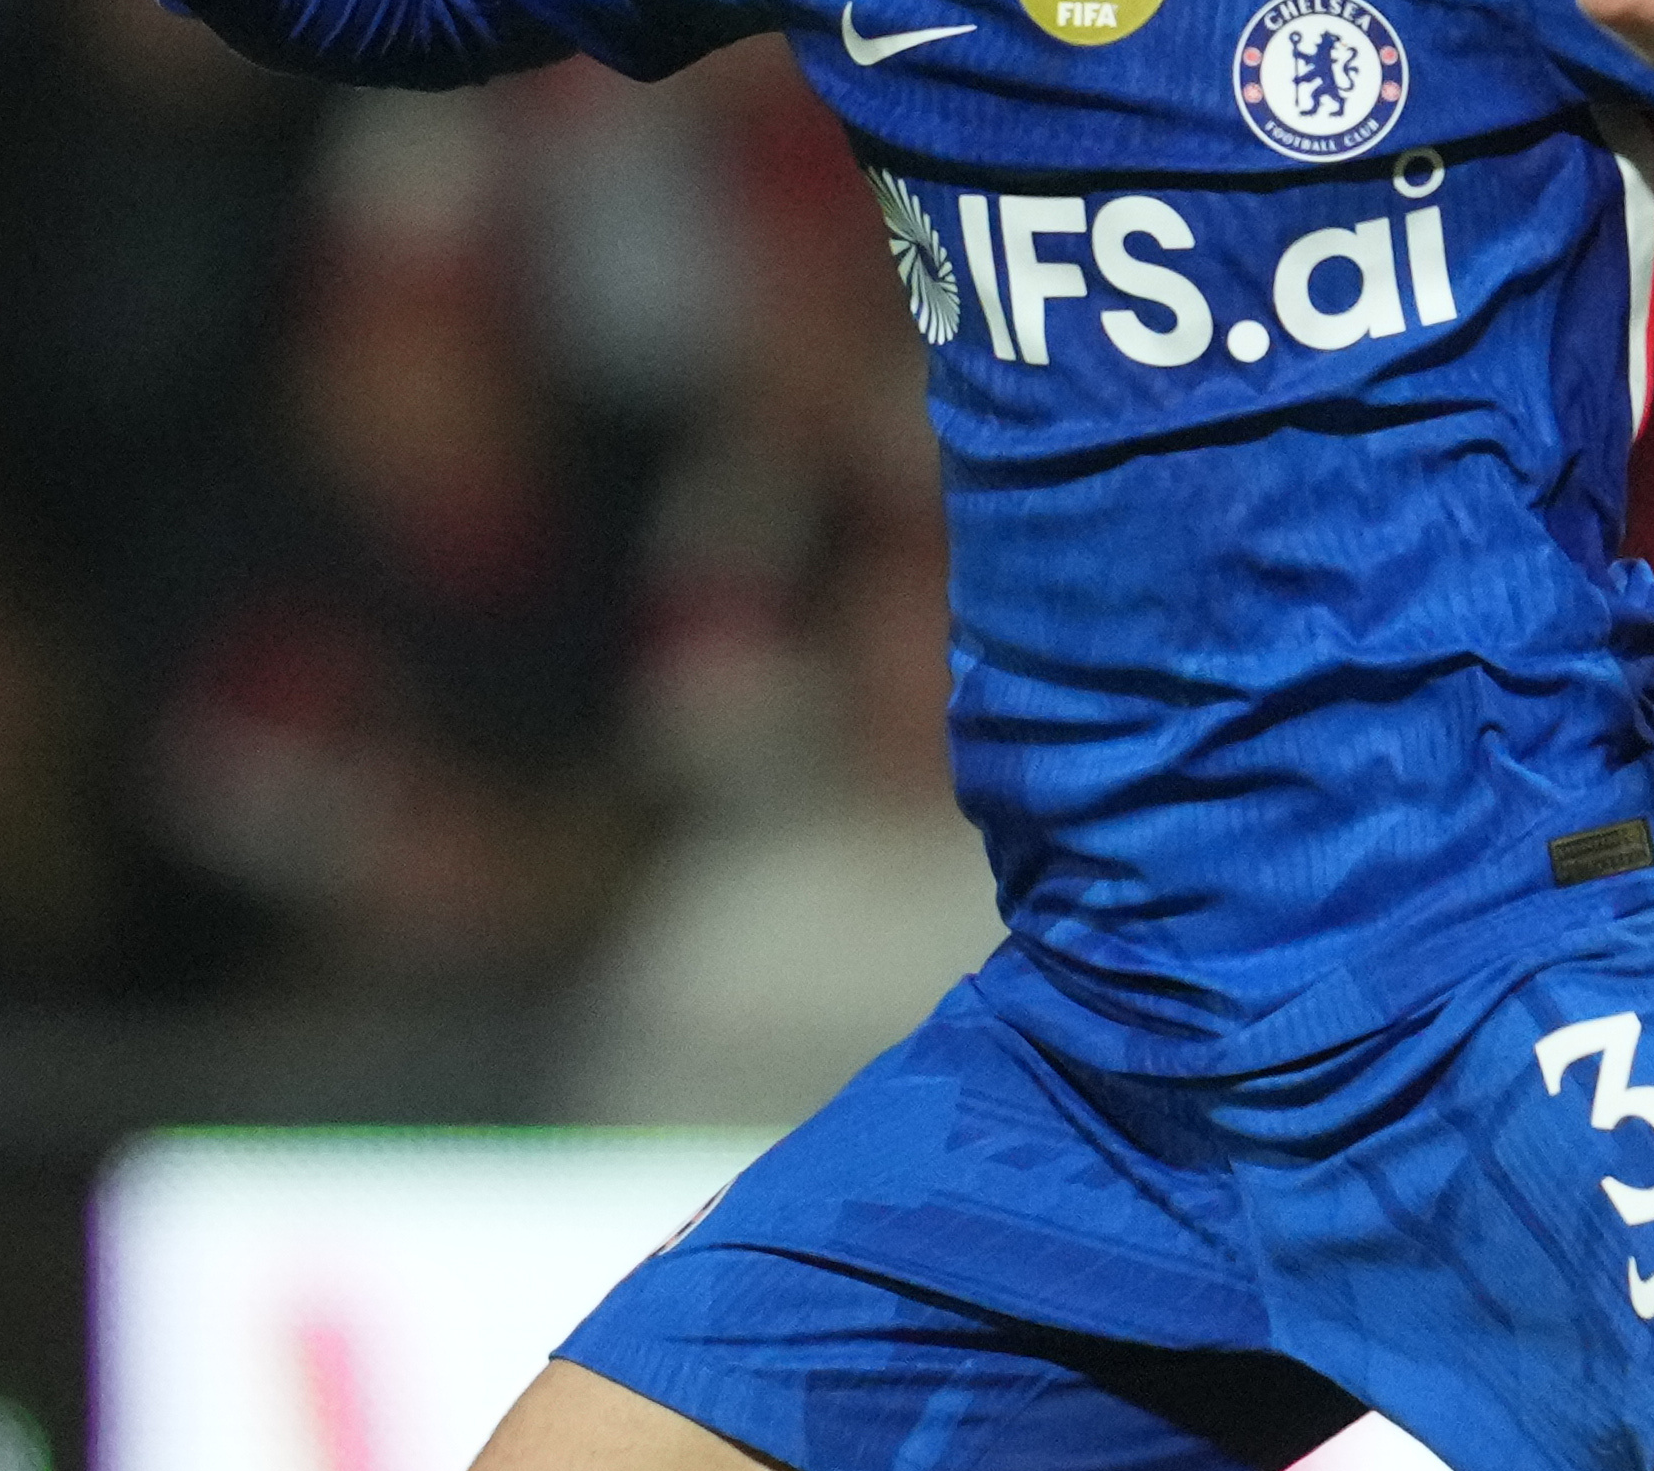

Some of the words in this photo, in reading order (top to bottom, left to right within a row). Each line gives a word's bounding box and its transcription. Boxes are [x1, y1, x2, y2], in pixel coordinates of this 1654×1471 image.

[1056, 0, 1118, 29] FIFA
[1264, 119, 1339, 152] FOOTBALL
[1343, 117, 1381, 147] CLUB
[957, 146, 1459, 368] IFS.ai
